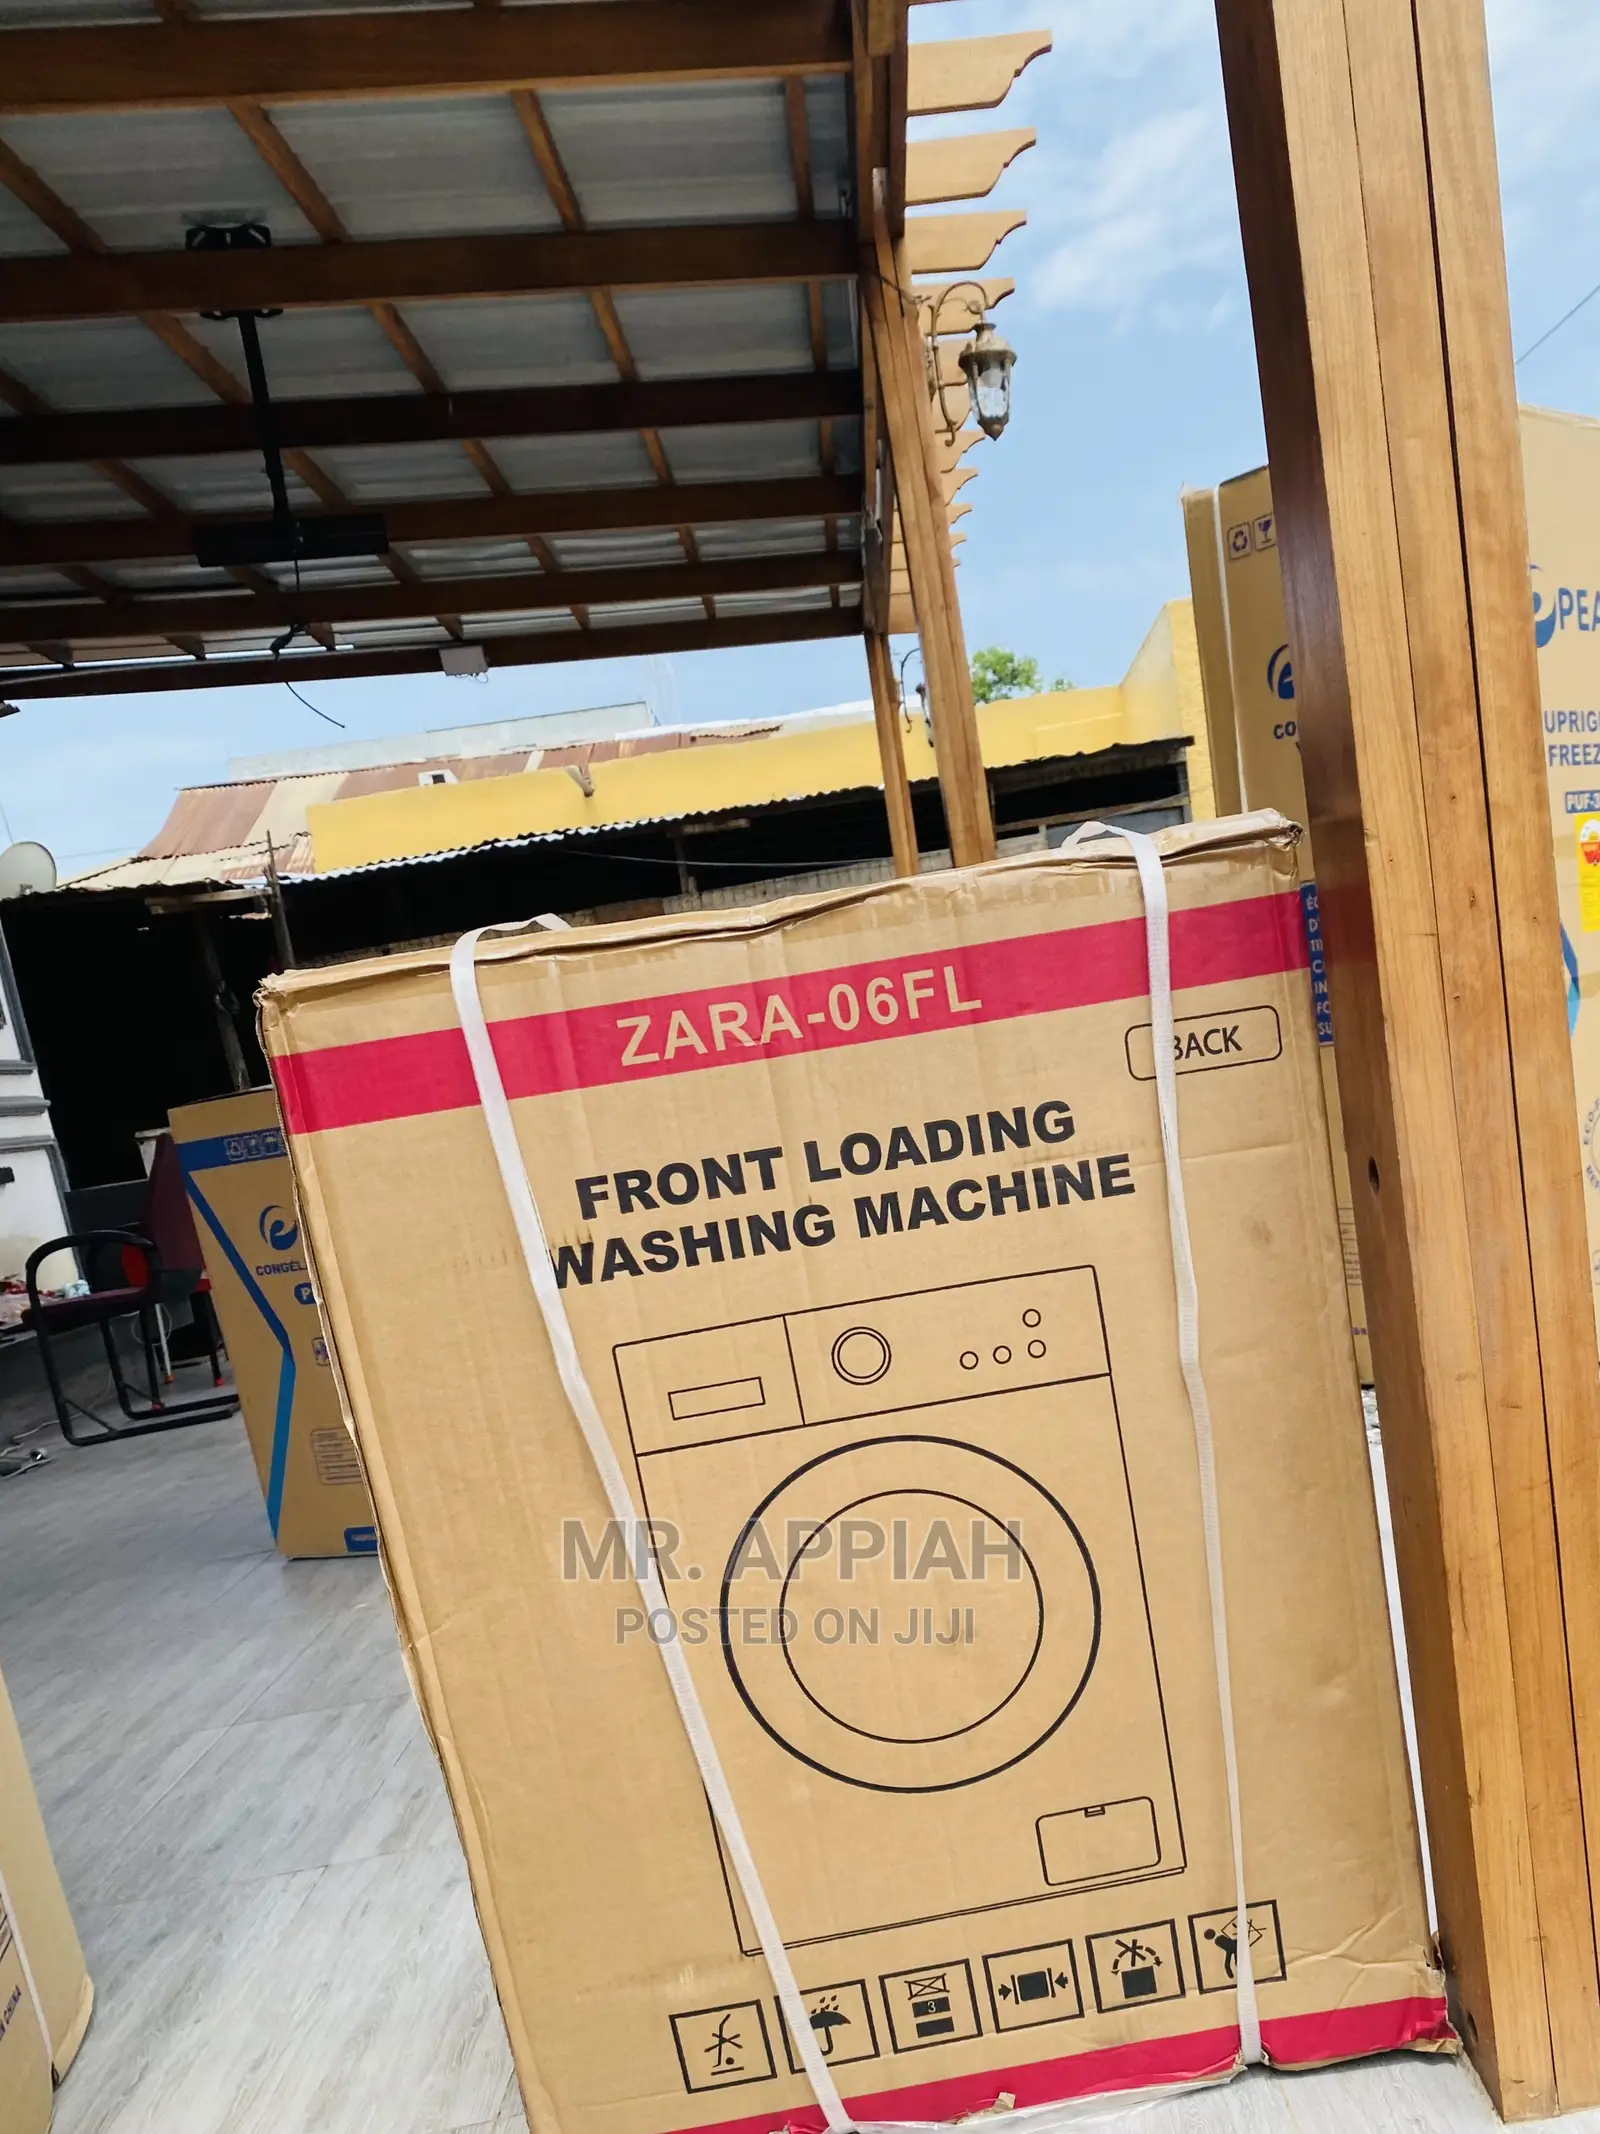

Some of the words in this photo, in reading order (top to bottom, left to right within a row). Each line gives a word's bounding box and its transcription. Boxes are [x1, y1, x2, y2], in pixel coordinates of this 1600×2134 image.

[1543, 710, 1600, 733] UPRIG
[616, 965, 983, 1066] ZARA-06FL
[575, 1146, 783, 1220] FRONT
[804, 1100, 1075, 1183] LOADING
[551, 1203, 836, 1289] WASHING
[853, 1153, 1136, 1239] MACHINE
[256, 1260, 306, 1275] CONGÉL
[927, 2000, 937, 2013] 3
